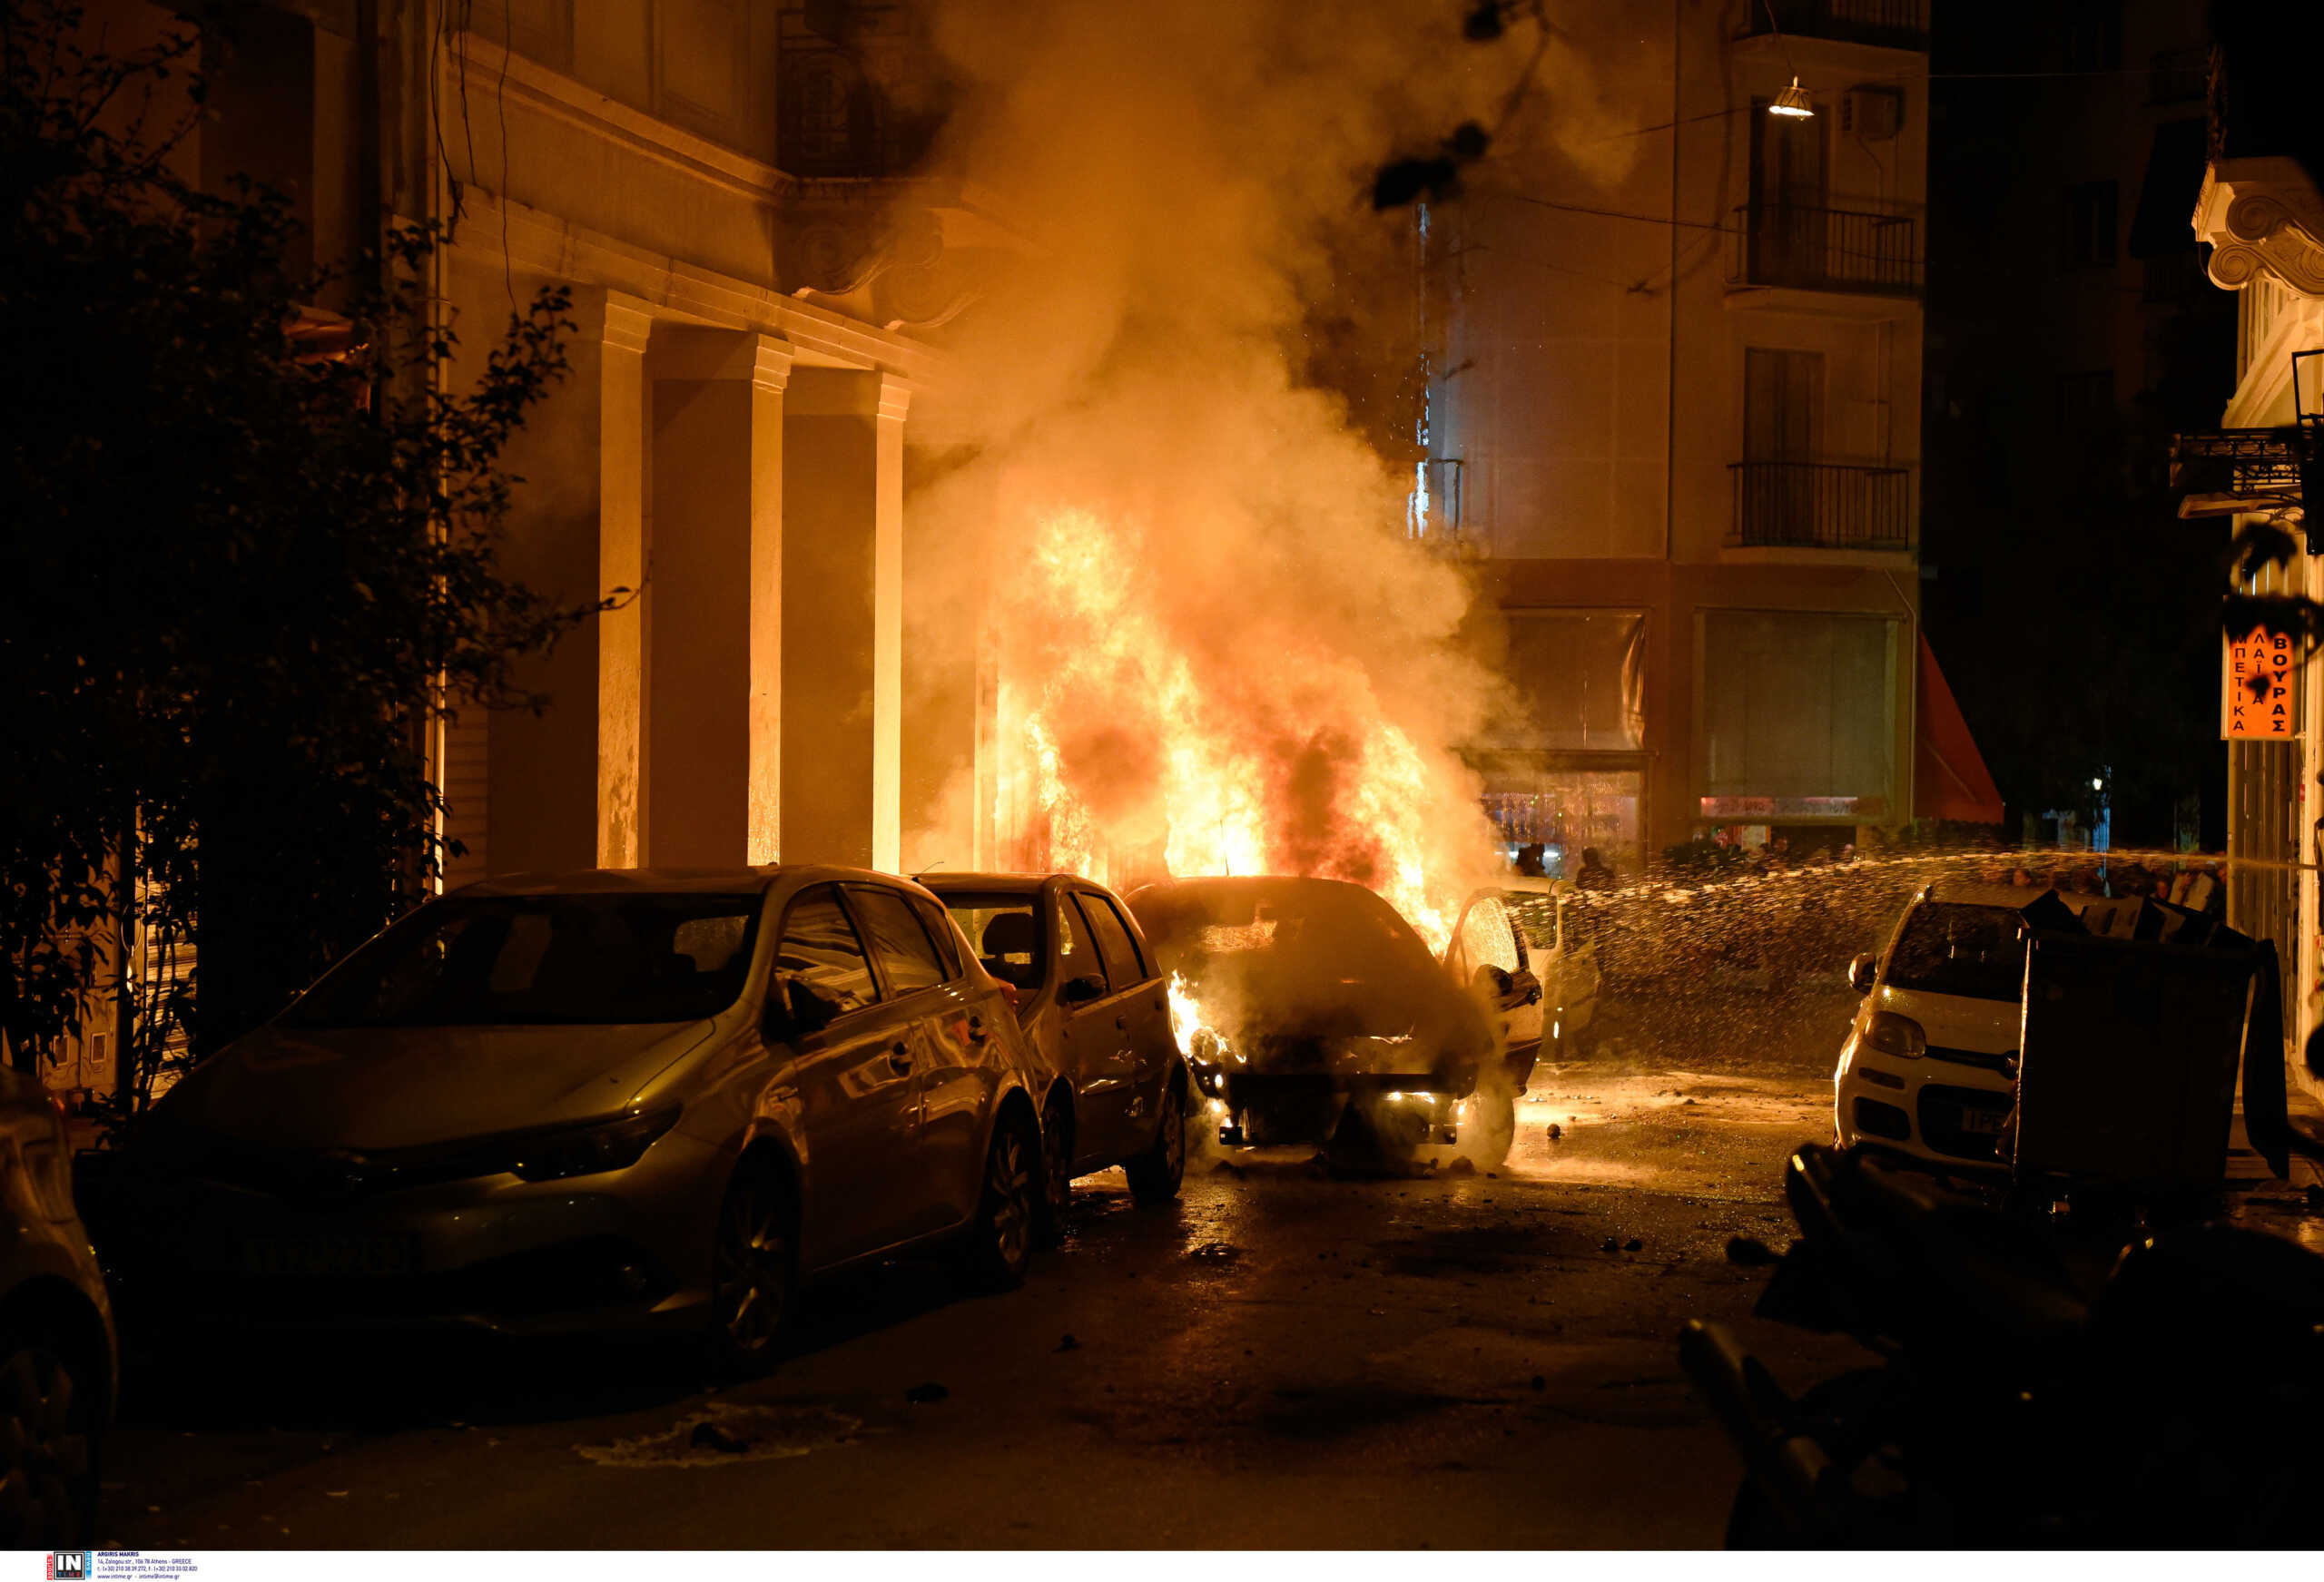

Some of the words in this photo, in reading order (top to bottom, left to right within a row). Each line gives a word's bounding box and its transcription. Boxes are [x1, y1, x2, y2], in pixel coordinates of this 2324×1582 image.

[2233, 635, 2247, 732] ΜΠΕΤΙΚΑ
[2252, 633, 2266, 705] ΛΑΪΑ
[2271, 637, 2288, 732] ΒΟΥΡΑΣ
